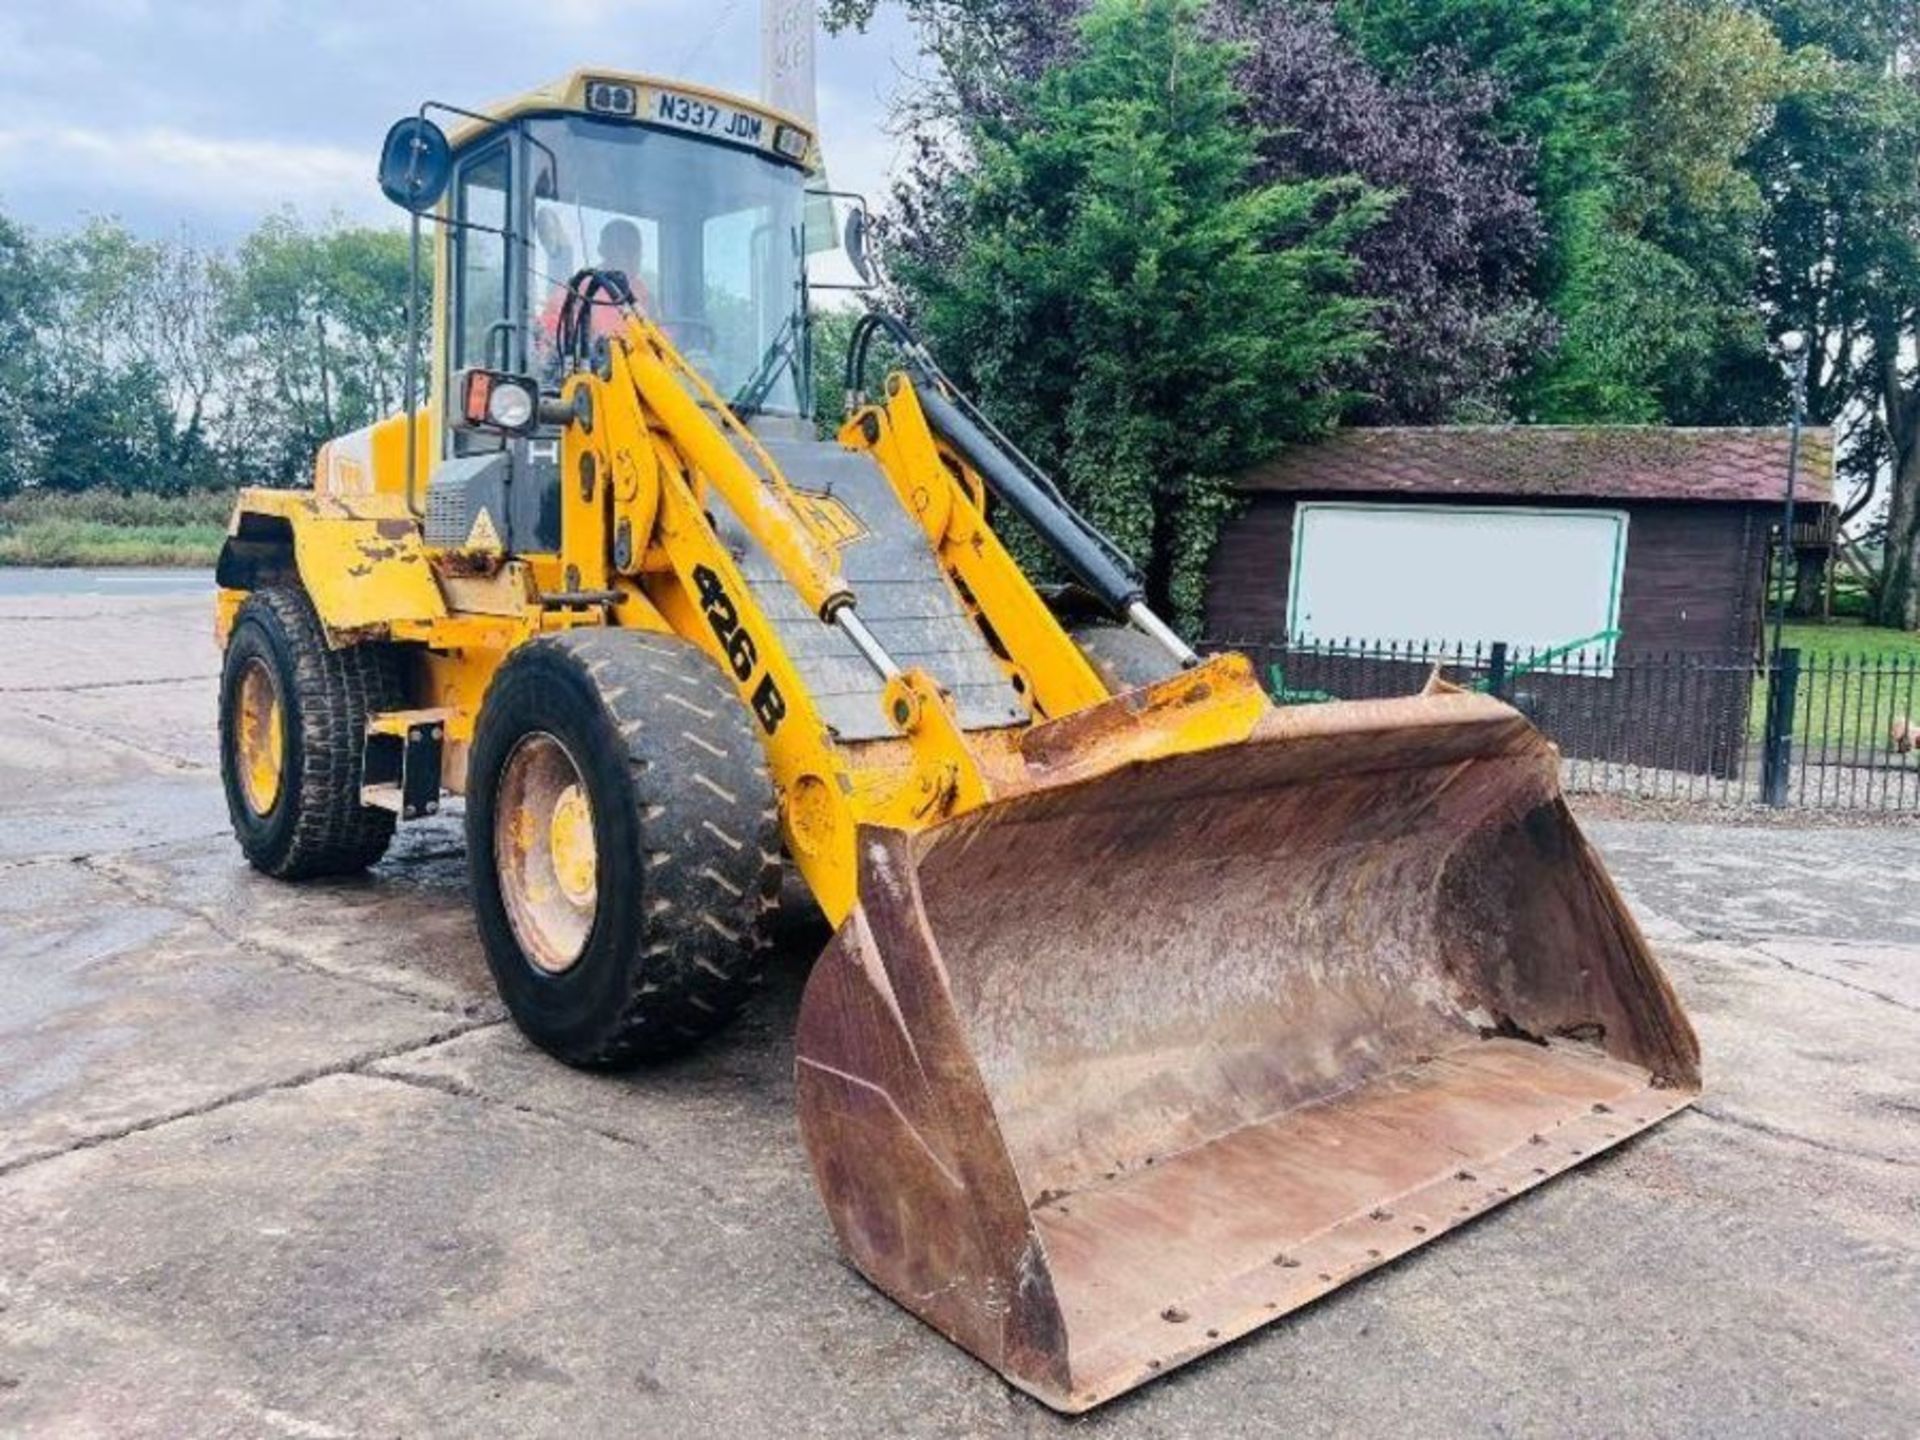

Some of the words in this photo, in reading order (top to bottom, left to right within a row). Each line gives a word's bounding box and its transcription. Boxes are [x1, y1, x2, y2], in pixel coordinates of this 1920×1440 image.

[659, 94, 719, 129] N337
[724, 112, 762, 140] JDM
[691, 563, 758, 683] 426
[750, 671, 787, 736] B
